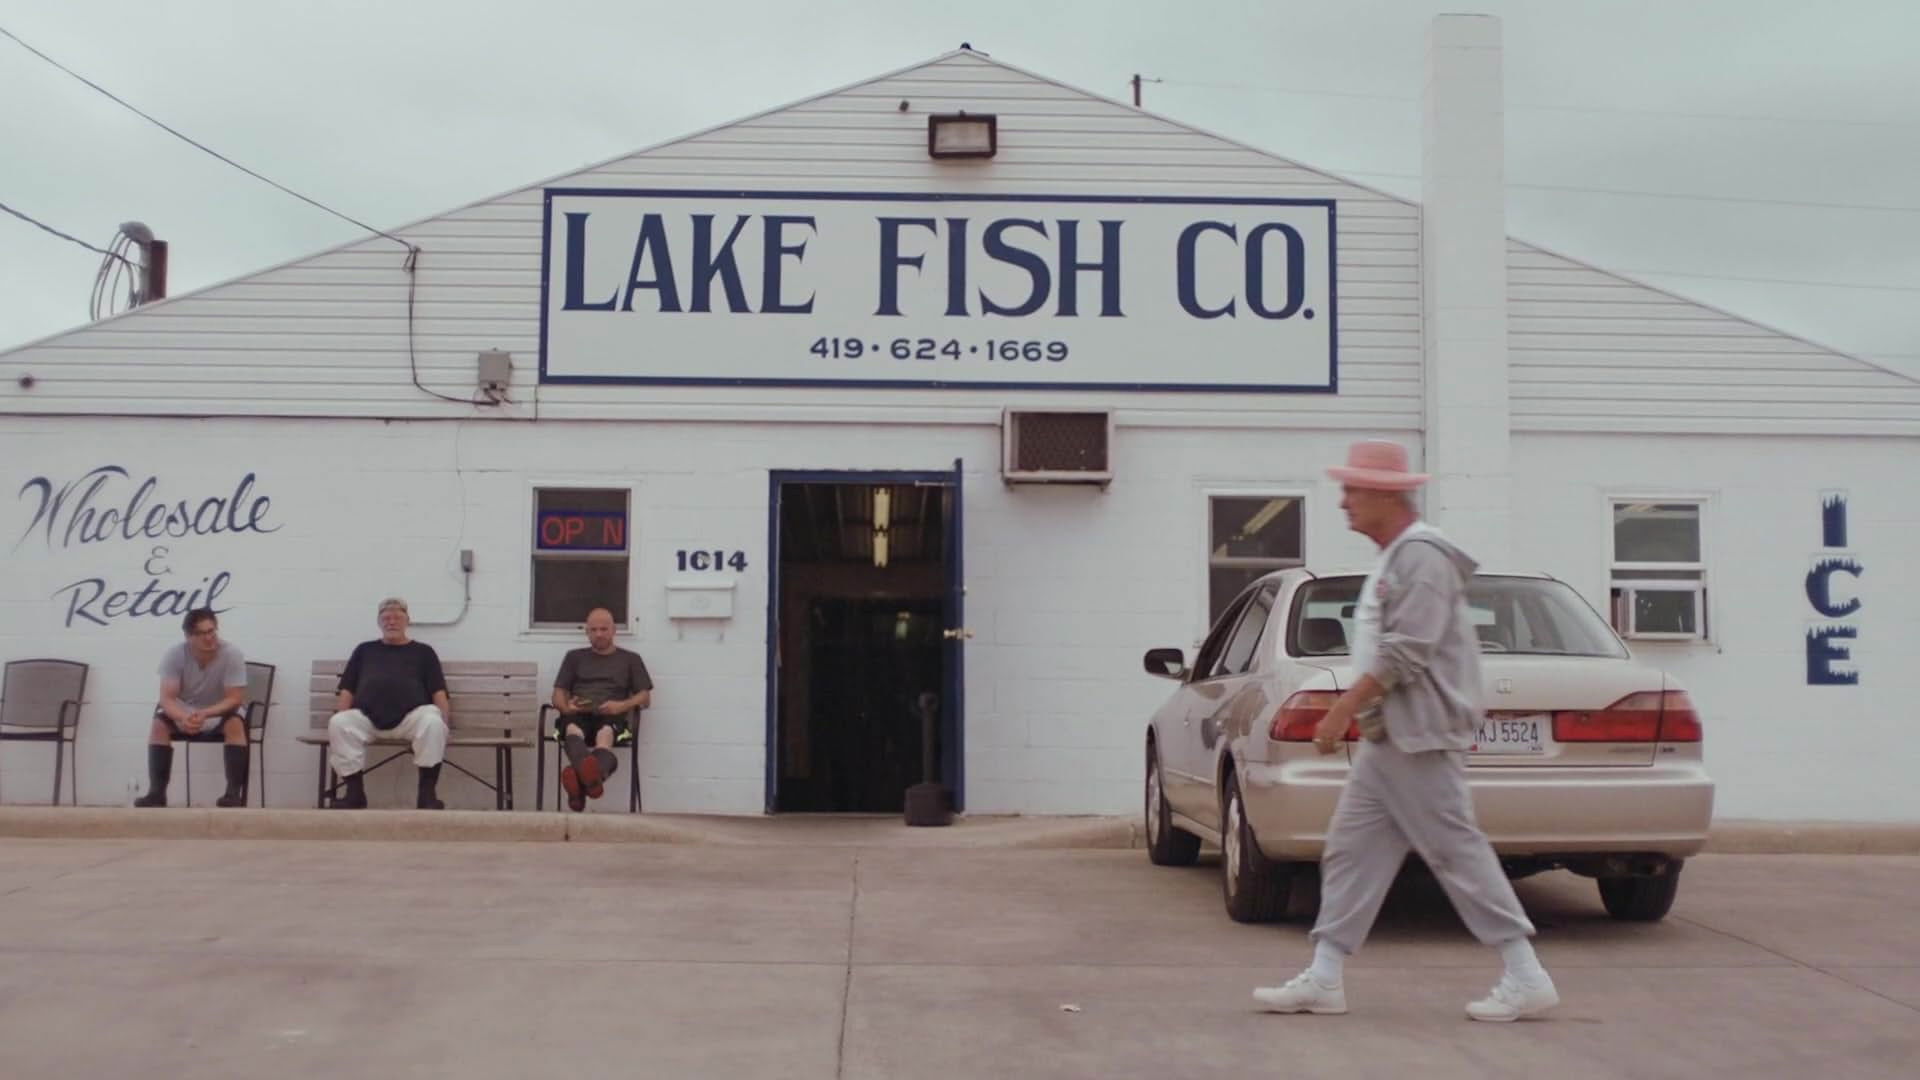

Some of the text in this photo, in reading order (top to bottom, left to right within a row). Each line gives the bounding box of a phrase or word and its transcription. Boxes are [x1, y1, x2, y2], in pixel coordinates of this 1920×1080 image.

[561, 212, 1314, 320] LAKE FISH CO.
[13, 464, 285, 552] Wholesale
[541, 516, 625, 546] OPN
[676, 550, 748, 573] 1014
[1805, 493, 1864, 686] ICE
[52, 570, 236, 628] Retail
[1501, 721, 1539, 743] 5524
